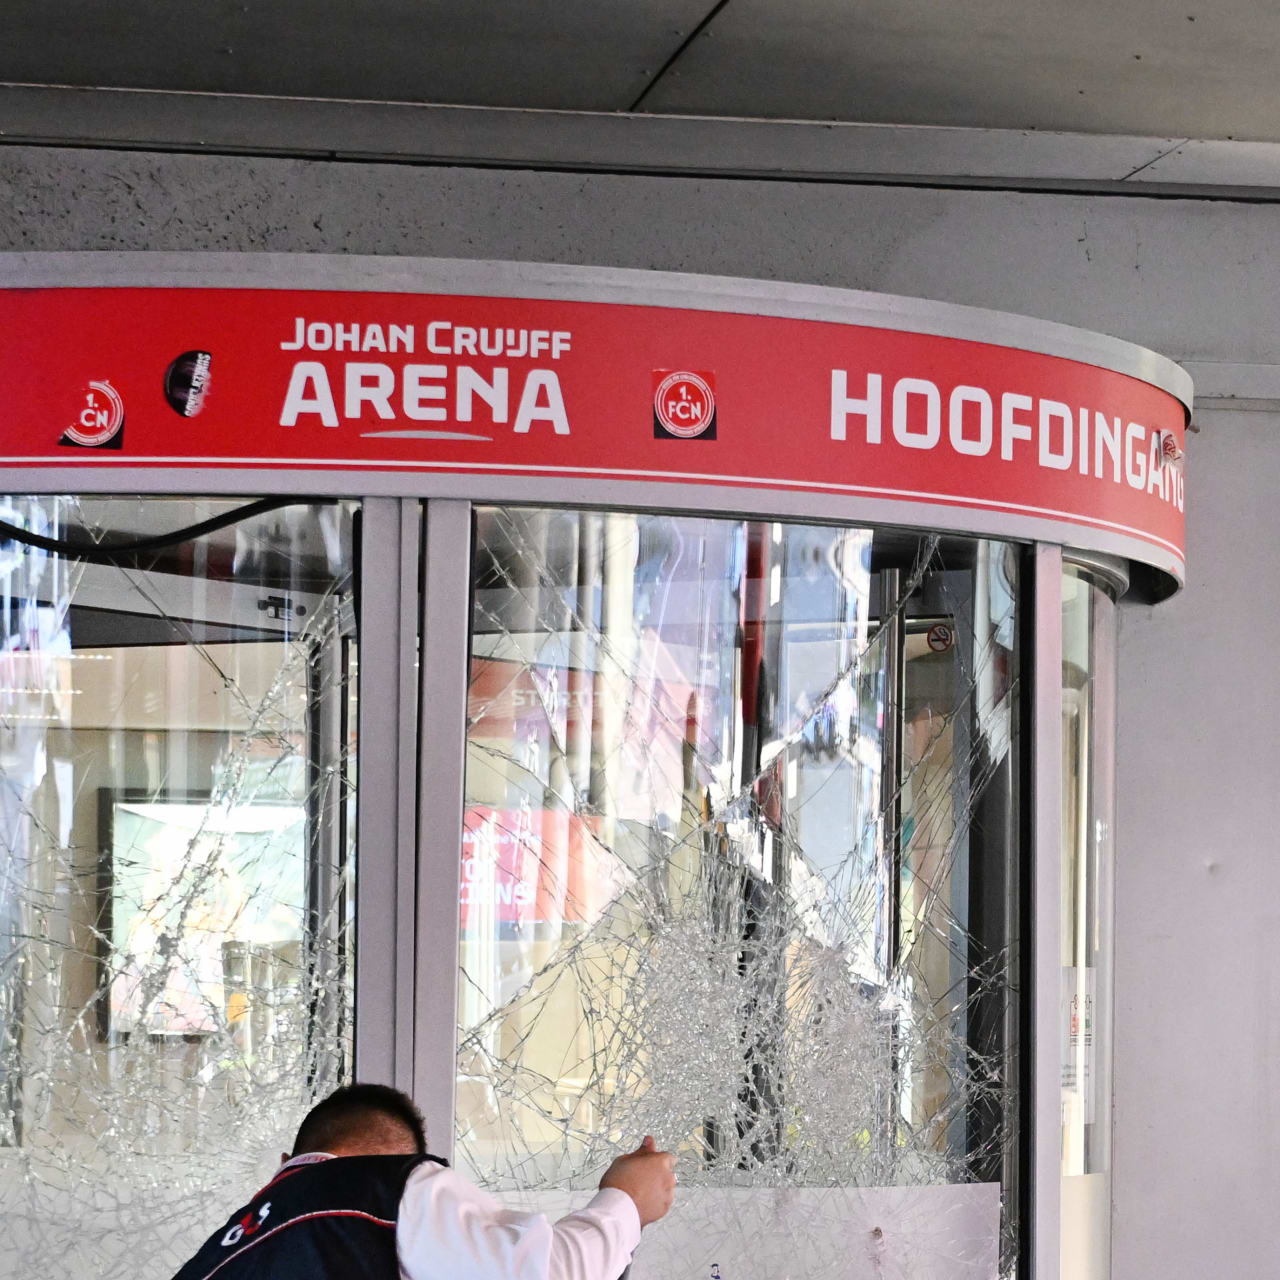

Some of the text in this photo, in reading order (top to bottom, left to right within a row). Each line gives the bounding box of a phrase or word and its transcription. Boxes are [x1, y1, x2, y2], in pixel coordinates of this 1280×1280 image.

[280, 317, 572, 360] JOHAN CRUIJFF
[278, 360, 571, 436] ARENA
[668, 400, 702, 420] FCN
